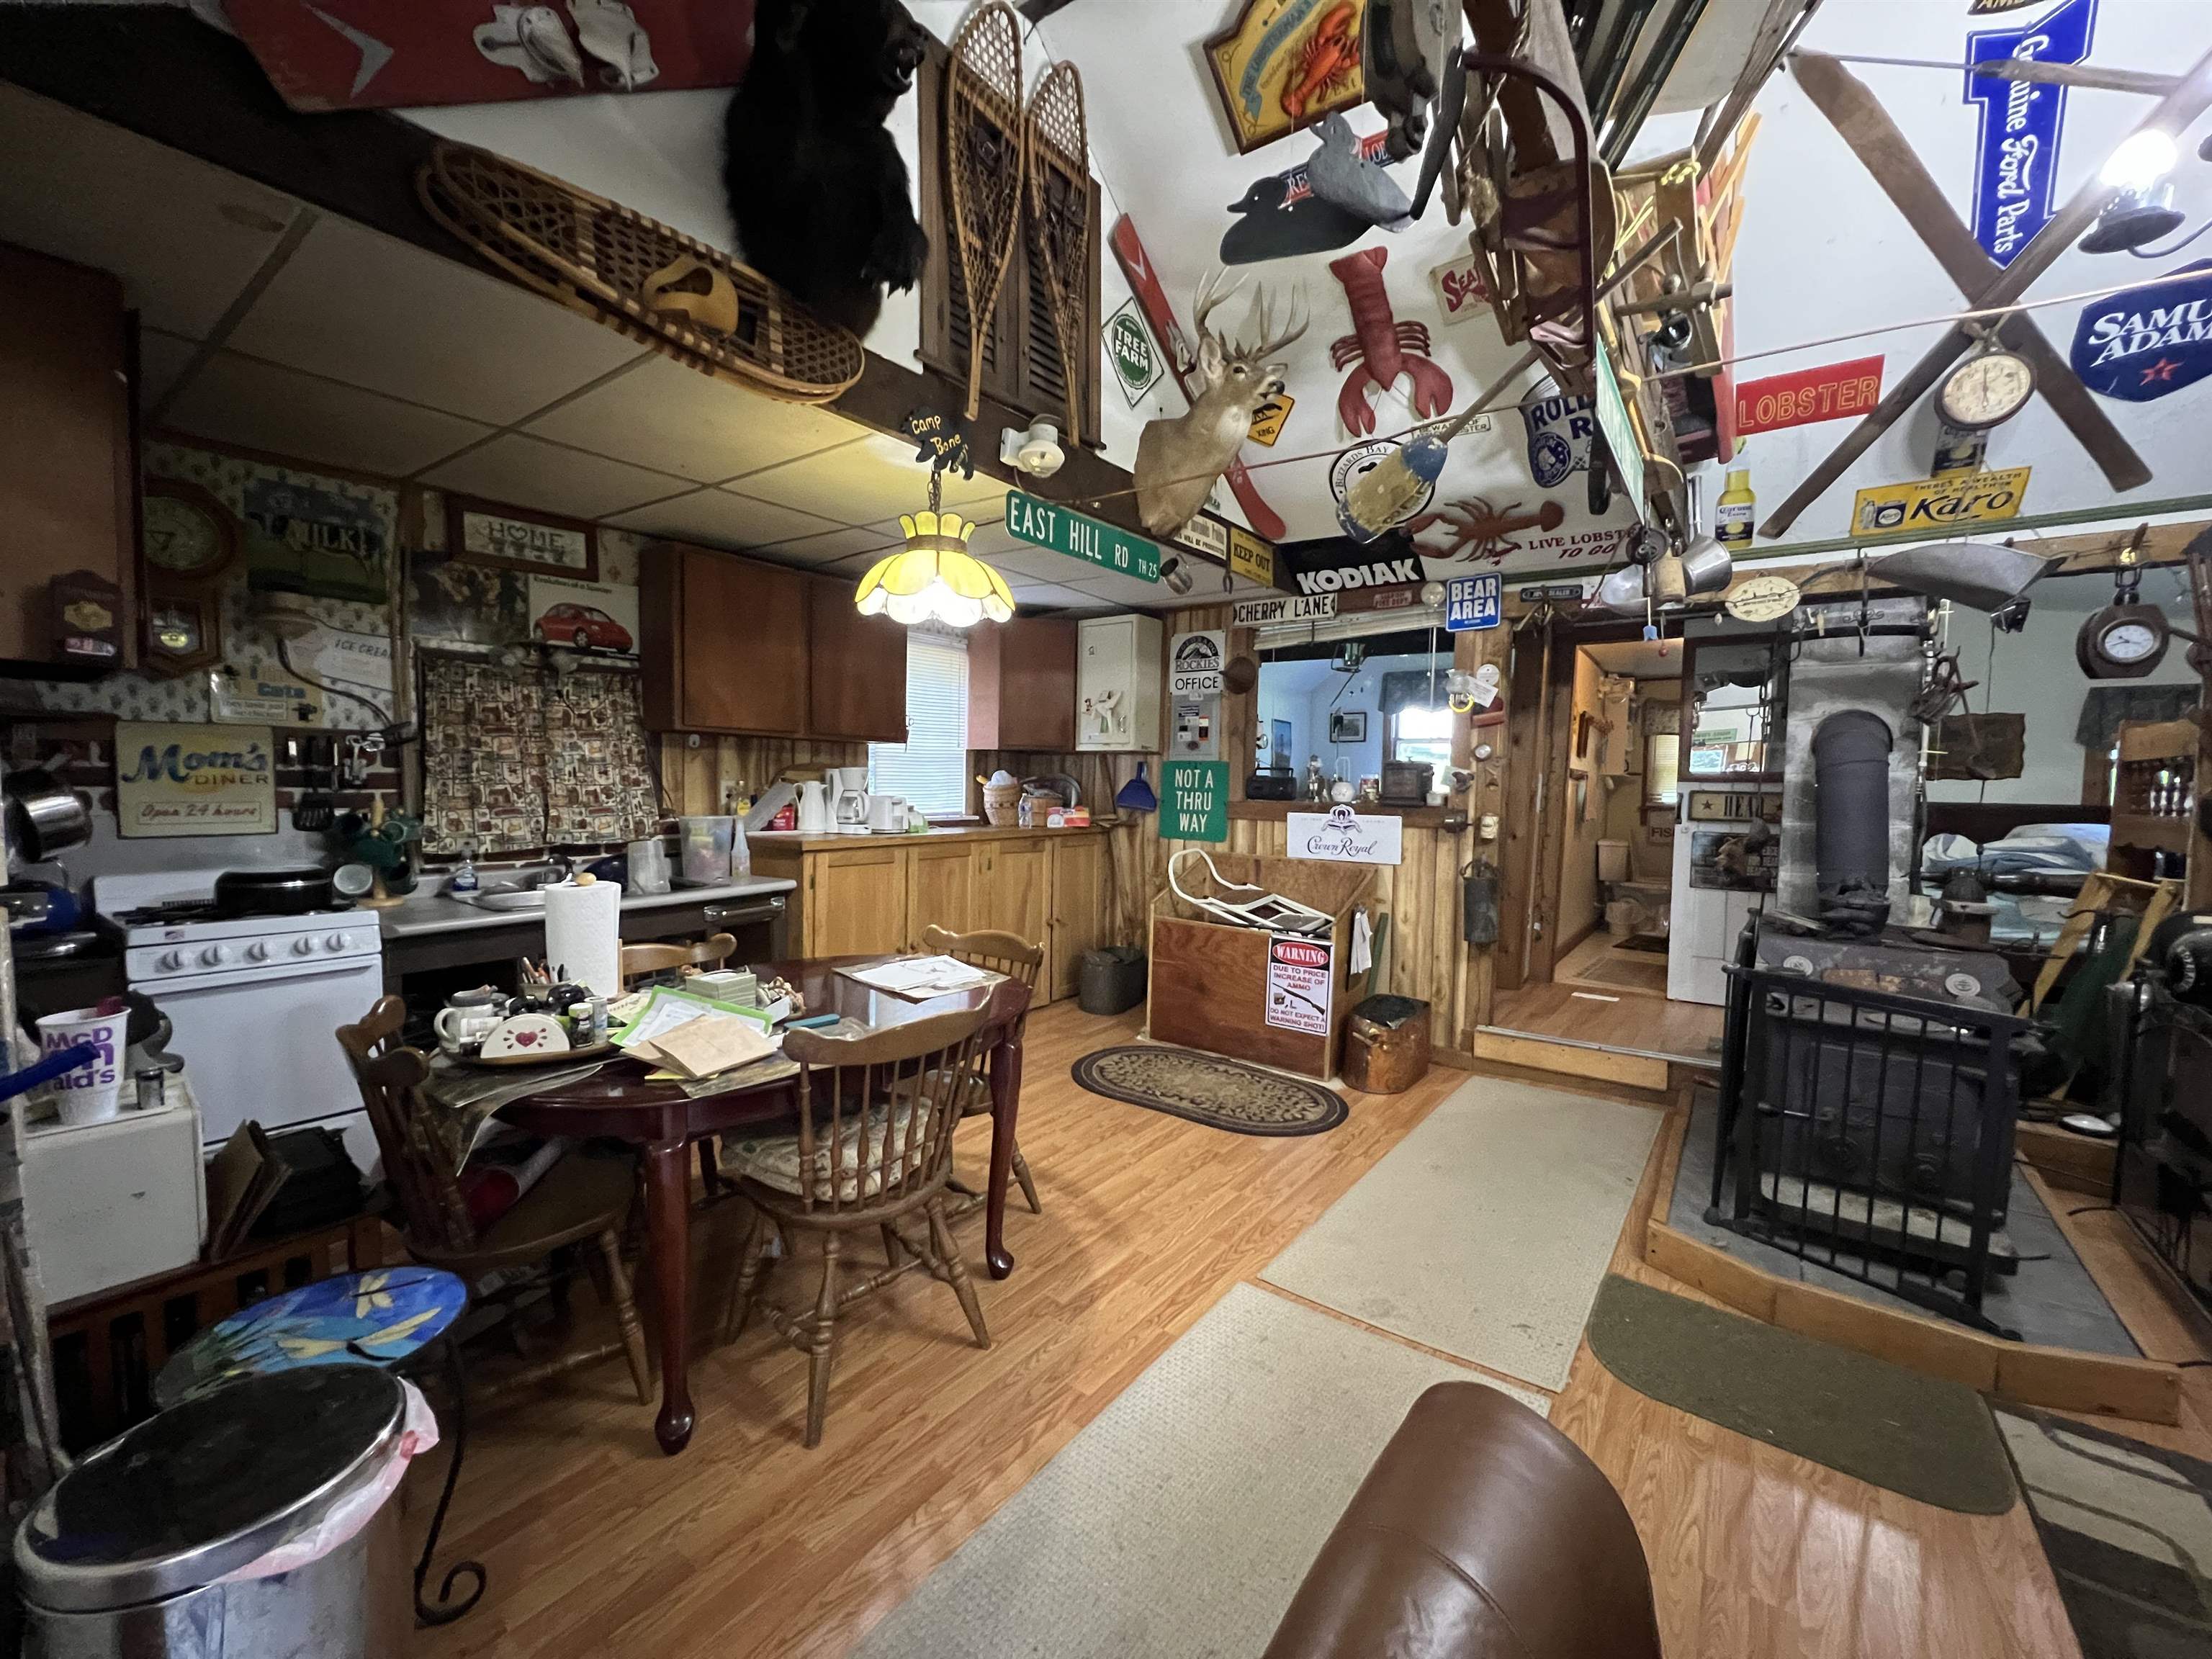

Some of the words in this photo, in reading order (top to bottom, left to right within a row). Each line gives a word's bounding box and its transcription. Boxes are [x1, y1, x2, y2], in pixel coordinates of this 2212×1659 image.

[1997, 134, 2038, 199] Ford
[1994, 199, 2031, 253] Parts
[1116, 325, 1148, 358] TREE
[1115, 339, 1148, 372] FARM
[1739, 375, 1878, 428] LOBSTER
[1256, 426, 1274, 437] XING
[1336, 449, 1364, 487] BUZZARDS
[1910, 490, 2013, 522] Karo
[1010, 496, 1056, 543] EAST
[1069, 519, 1102, 560] HILL
[1115, 544, 1128, 568] RD
[1138, 559, 1146, 575] TH
[1148, 563, 1157, 577] 25
[1529, 537, 1565, 550] LIVE
[1233, 543, 1254, 562] KEEP
[1256, 554, 1269, 572] OUT
[1559, 547, 1583, 559] TO
[1588, 544, 1617, 555] GO
[1297, 558, 1420, 595] KODIAK
[1452, 577, 1496, 602] BEAR
[1238, 600, 1287, 623] CHERRY
[1295, 595, 1328, 617] LANE
[1450, 598, 1496, 621] AREA
[360, 644, 390, 658] CREA
[1175, 657, 1219, 670] ROCKIES
[1175, 677, 1219, 690] OFFICE
[121, 742, 268, 783] Mom's
[194, 775, 269, 784] DINER
[1175, 768, 1200, 788] NOT
[1205, 769, 1213, 788] A
[1176, 791, 1212, 811] THRU
[142, 804, 179, 821] Open
[186, 804, 209, 816] 24
[212, 804, 257, 816] hours
[1179, 813, 1208, 832] WAY
[1307, 835, 1339, 855] Crown
[1332, 837, 1377, 857] Royal
[1277, 944, 1325, 965] WARNING
[1274, 972, 1312, 984] INCREASE
[1303, 969, 1326, 979] PRICE
[1287, 982, 1310, 991] AMMO
[1270, 1015, 1301, 1025] WARNING
[1295, 1012, 1319, 1022] EXPECT
